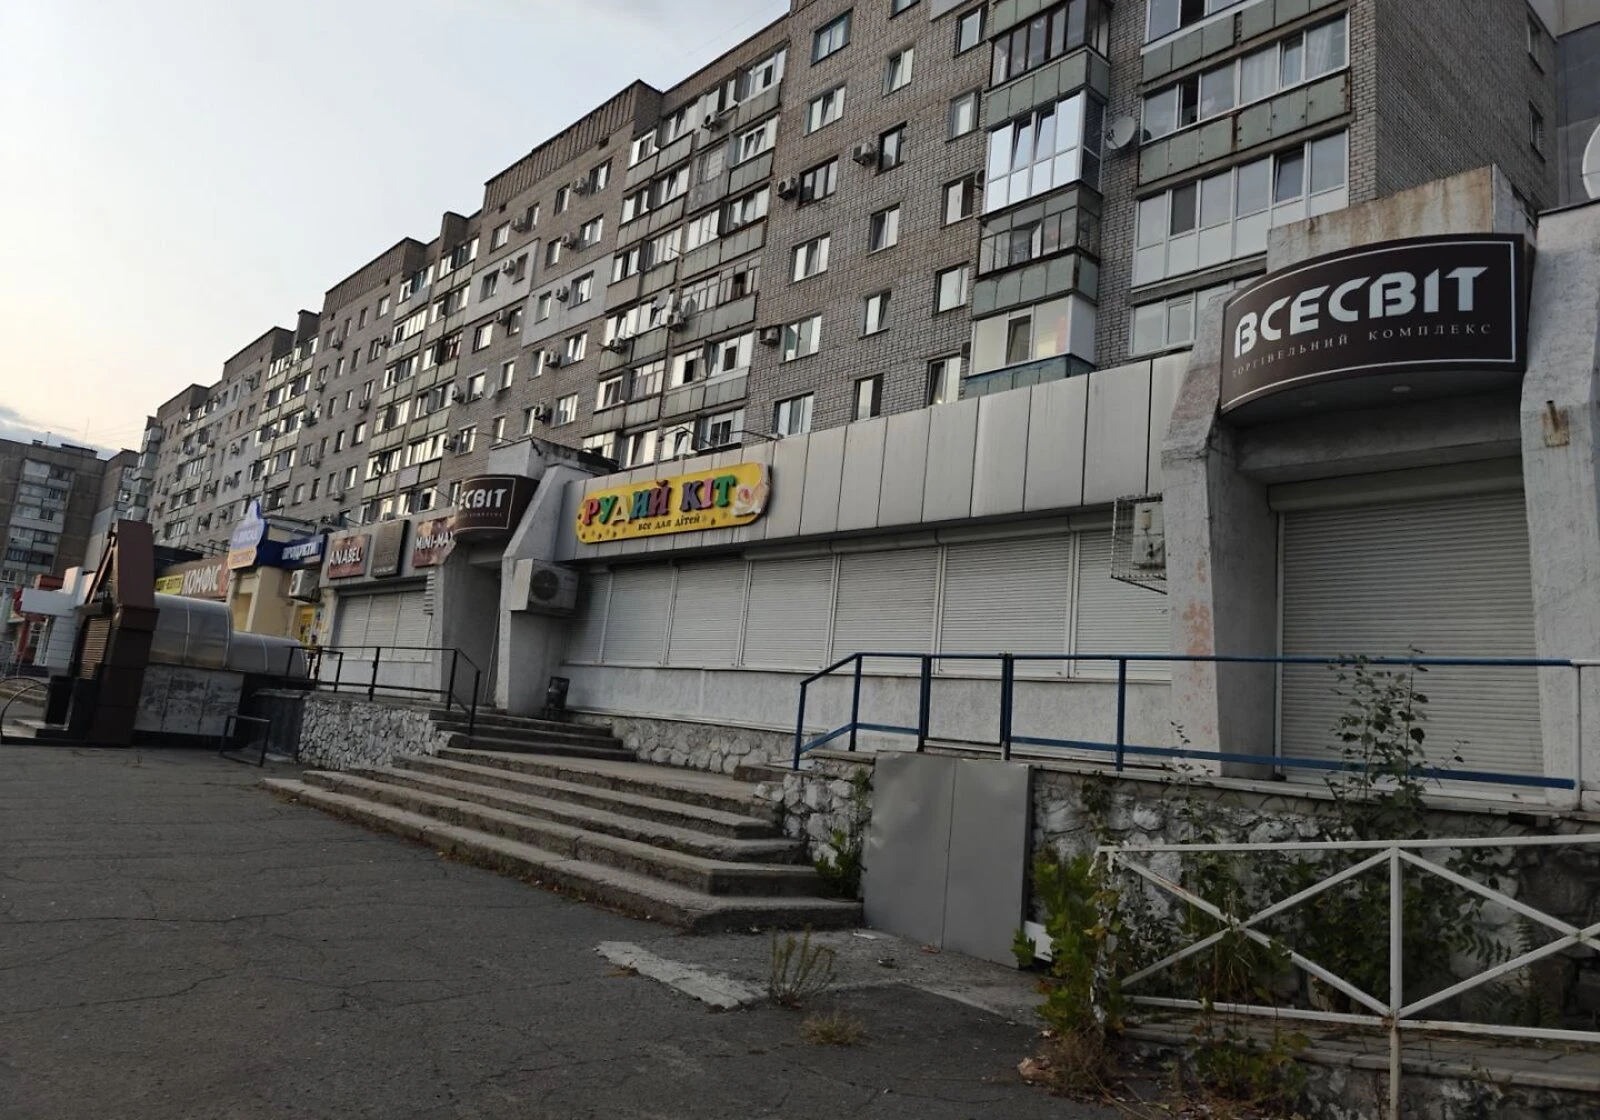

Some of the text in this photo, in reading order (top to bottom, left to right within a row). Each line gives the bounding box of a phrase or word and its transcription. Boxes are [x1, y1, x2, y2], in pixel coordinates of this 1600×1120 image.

[1234, 266, 1488, 358] ВСЕСВІТ
[1368, 323, 1492, 341] КОМПЛЕКС
[582, 475, 736, 526] РУДИЙ КІТ
[329, 546, 362, 566] ANABEL
